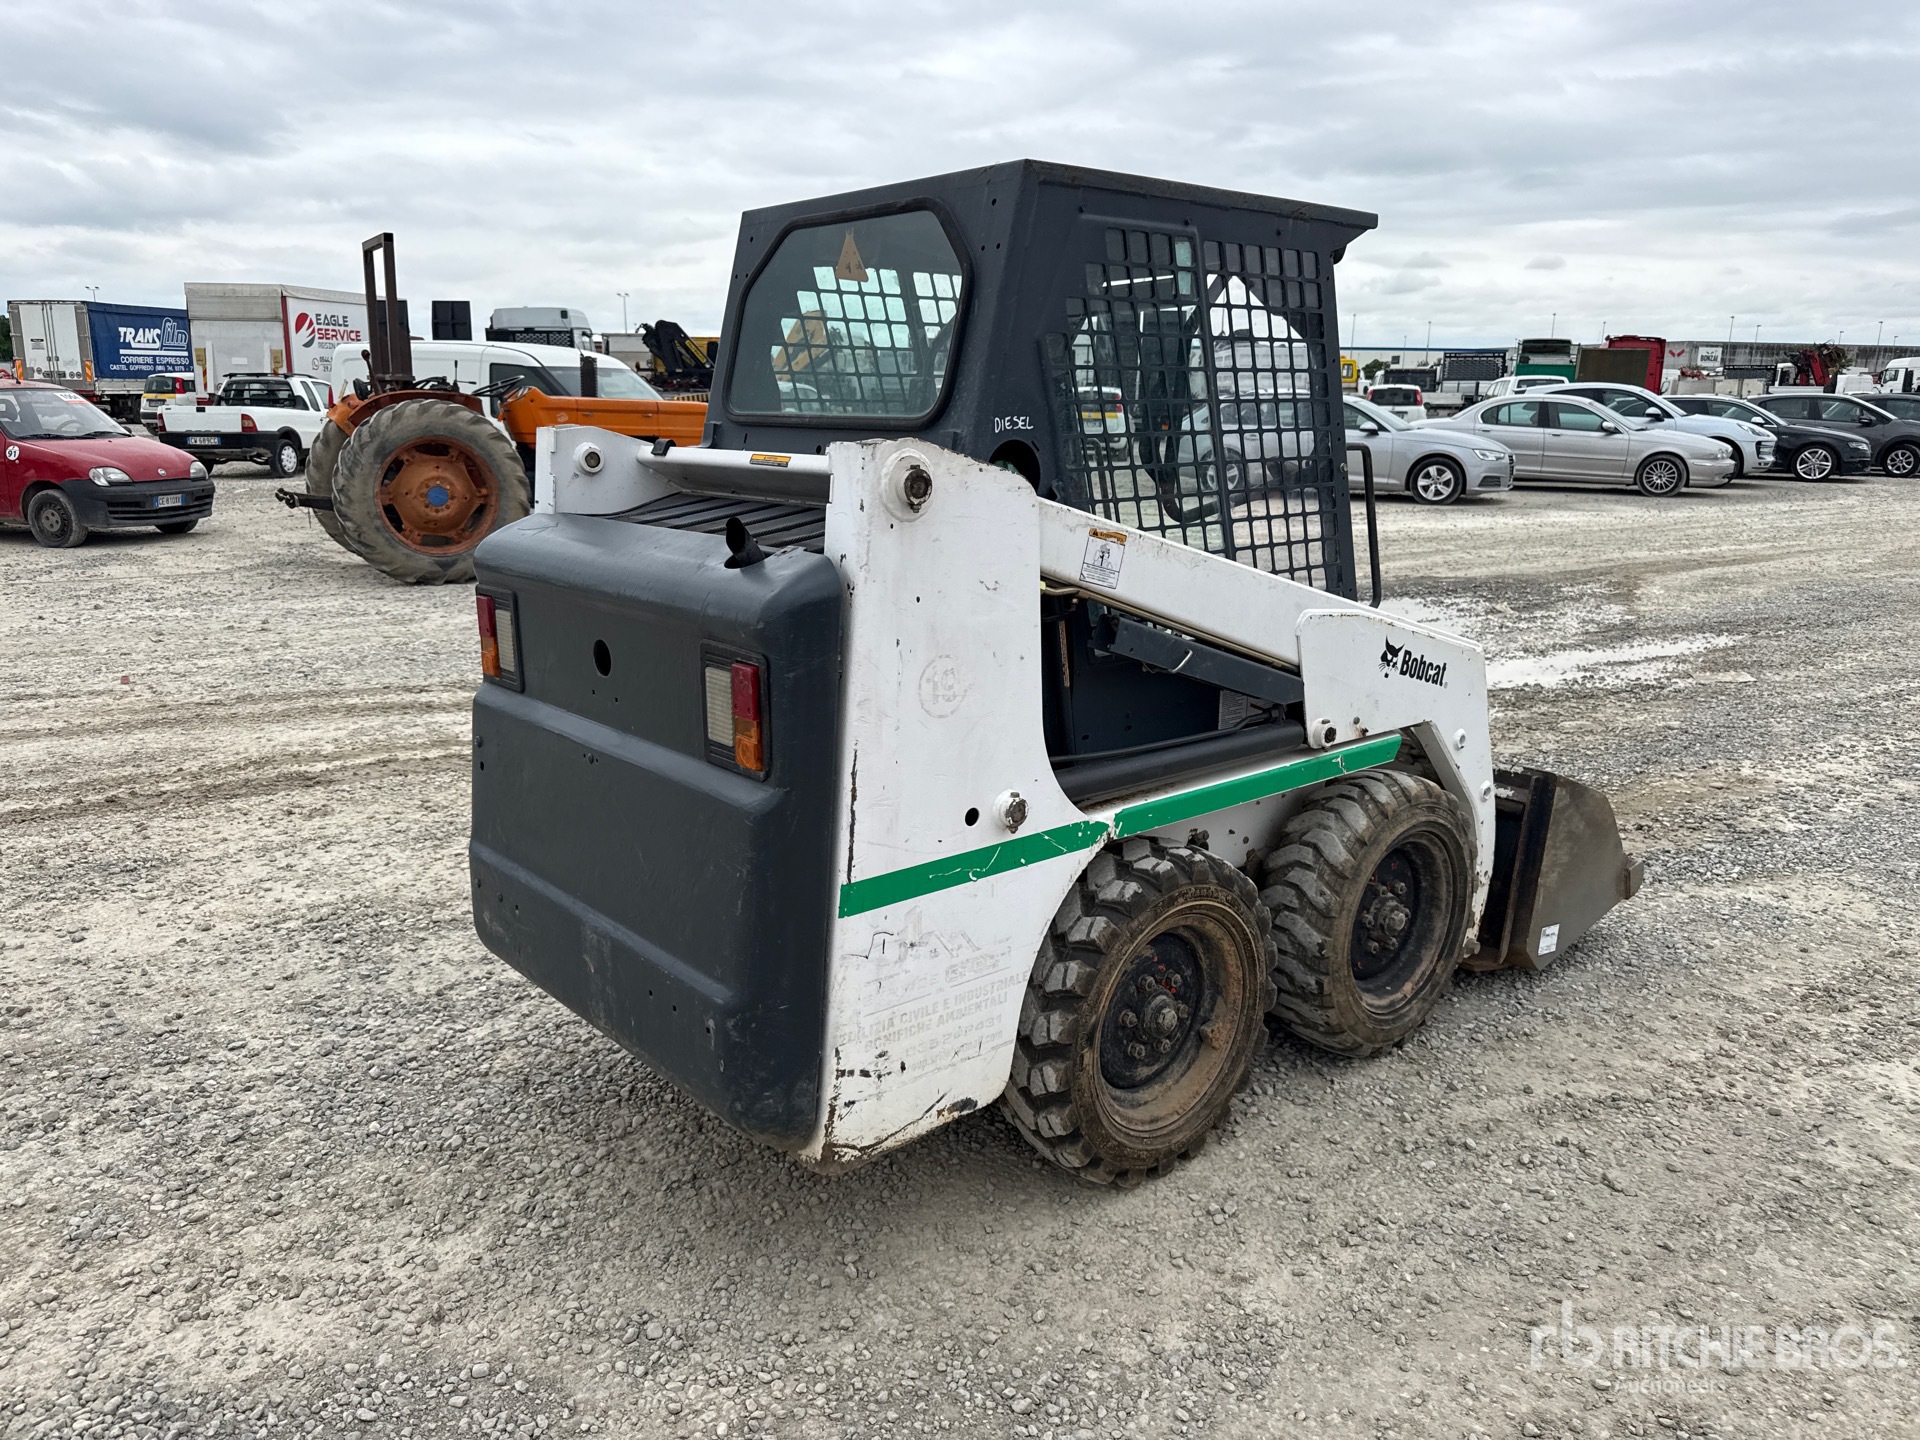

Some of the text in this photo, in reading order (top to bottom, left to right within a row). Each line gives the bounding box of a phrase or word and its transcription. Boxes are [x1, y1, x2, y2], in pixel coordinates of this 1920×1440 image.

[315, 313, 349, 327] EAGLE
[317, 328, 362, 342] SERVICE
[120, 356, 189, 365] CORRIERE ESPRESSO
[994, 415, 1034, 433] DIESEL
[1399, 649, 1447, 687] Bobcat
[899, 1001, 939, 1025] CIVILE
[943, 998, 951, 1010] E
[954, 969, 1030, 1006] INDUSTRIALE
[936, 991, 1008, 1028] AMBIENTALI
